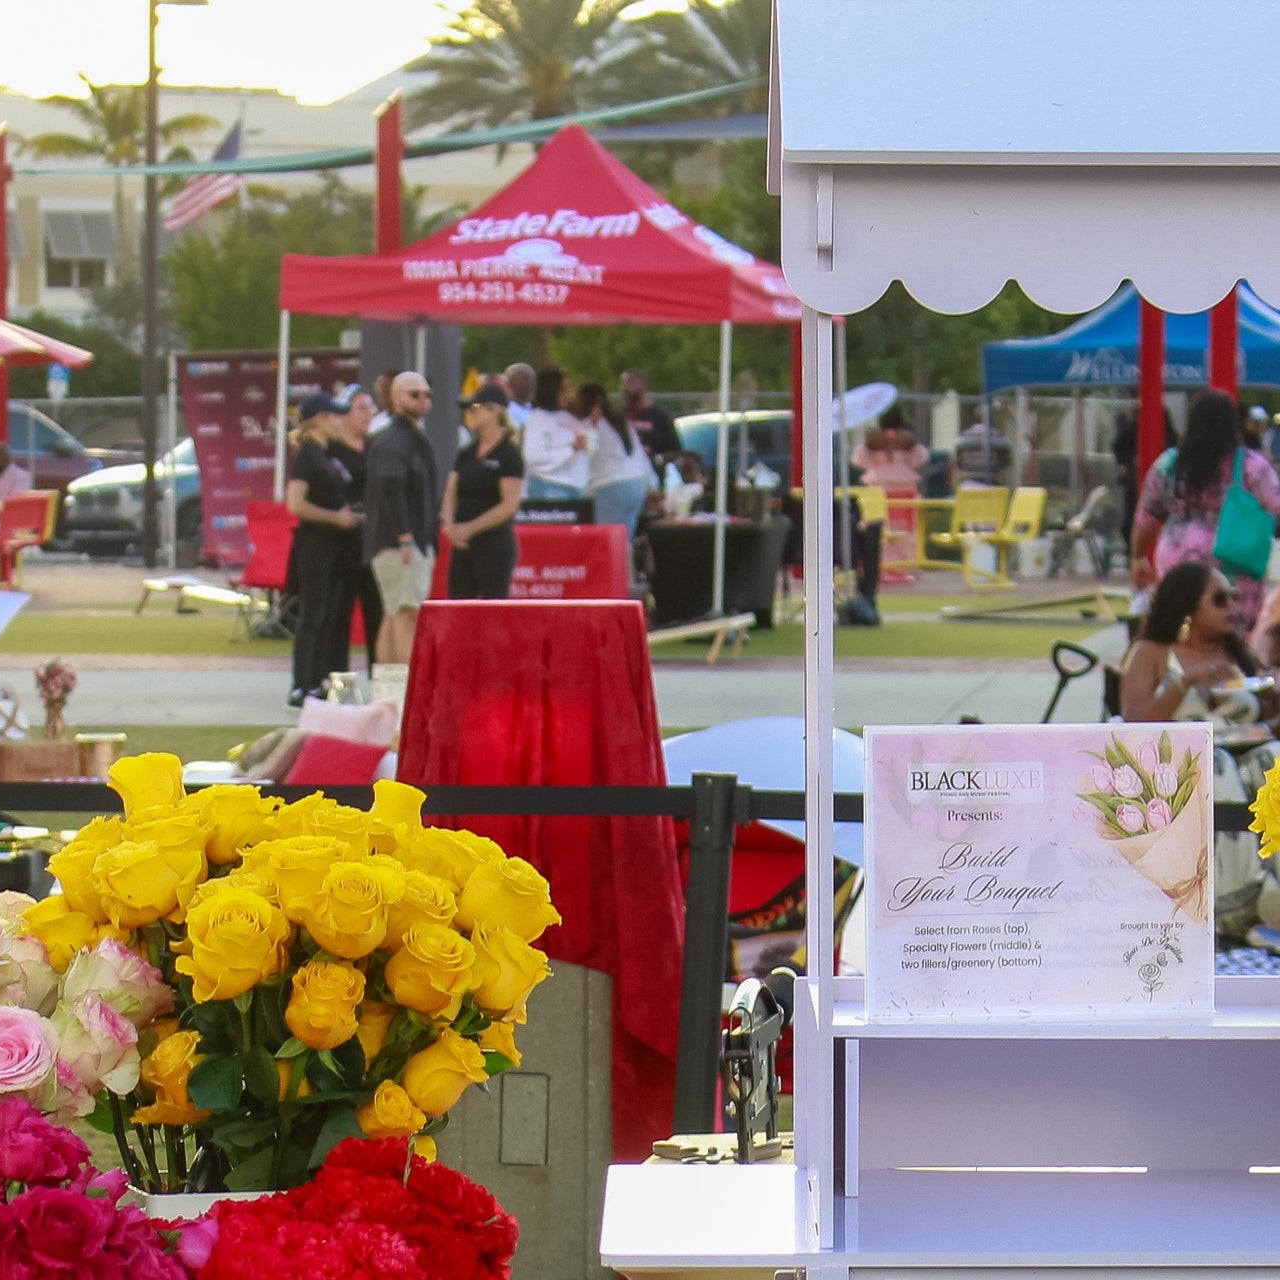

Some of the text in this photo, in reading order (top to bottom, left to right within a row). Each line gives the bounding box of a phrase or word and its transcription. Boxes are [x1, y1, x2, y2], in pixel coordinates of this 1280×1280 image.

[438, 281, 570, 305] 954-251-4537
[1064, 354, 1203, 382] WELLITON
[947, 810, 1003, 822] Presents:
[938, 842, 1020, 874] Build
[887, 877, 957, 912] Your
[964, 874, 1064, 910] Bouquet
[915, 926, 944, 936] Select
[947, 925, 970, 935] from
[972, 925, 1001, 934] Roses
[1120, 922, 1149, 930] Brought
[903, 939, 1042, 955] Specialty Flowers (middle) &
[901, 960, 919, 969] two
[921, 957, 995, 971] fillers/greenery
